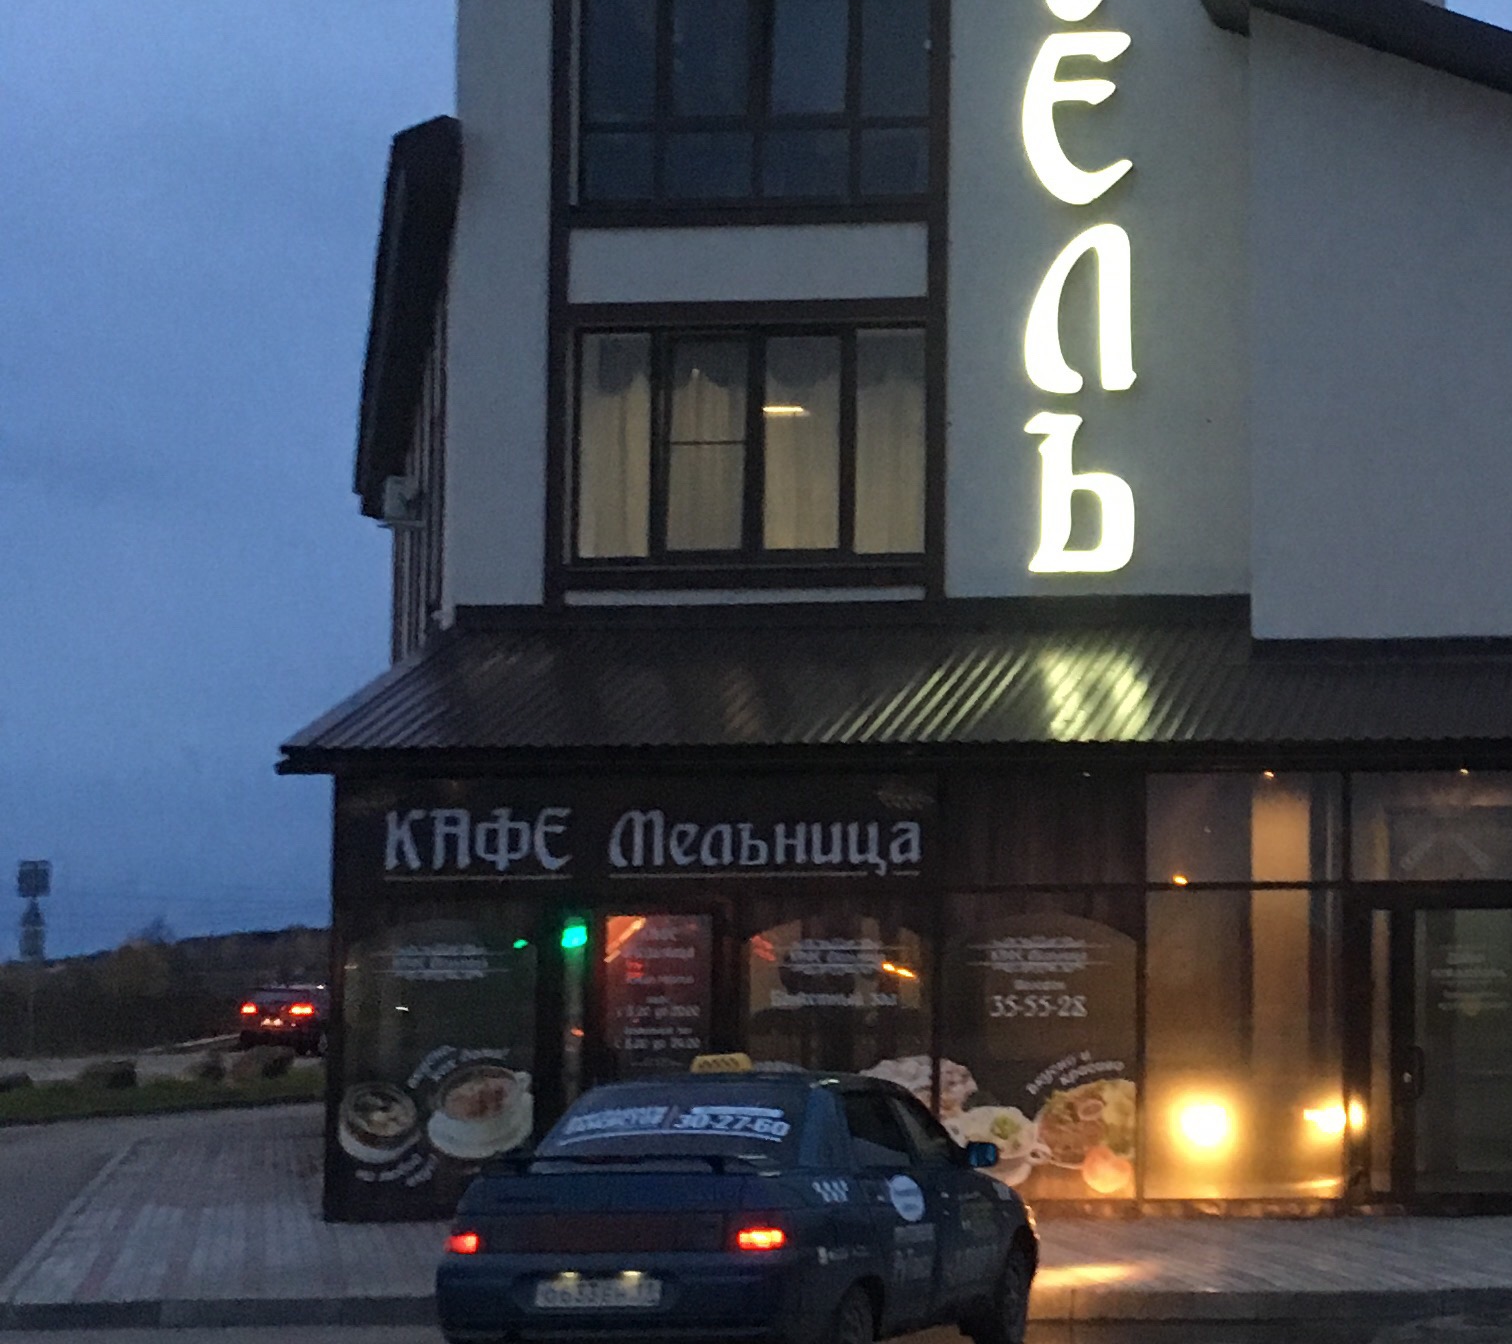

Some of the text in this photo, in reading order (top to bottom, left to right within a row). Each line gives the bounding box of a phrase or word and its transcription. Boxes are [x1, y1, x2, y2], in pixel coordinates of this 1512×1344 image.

[608, 809, 922, 875] Мельница
[989, 994, 1089, 1018] 35-55-28
[673, 1113, 792, 1138] 30-27-60
